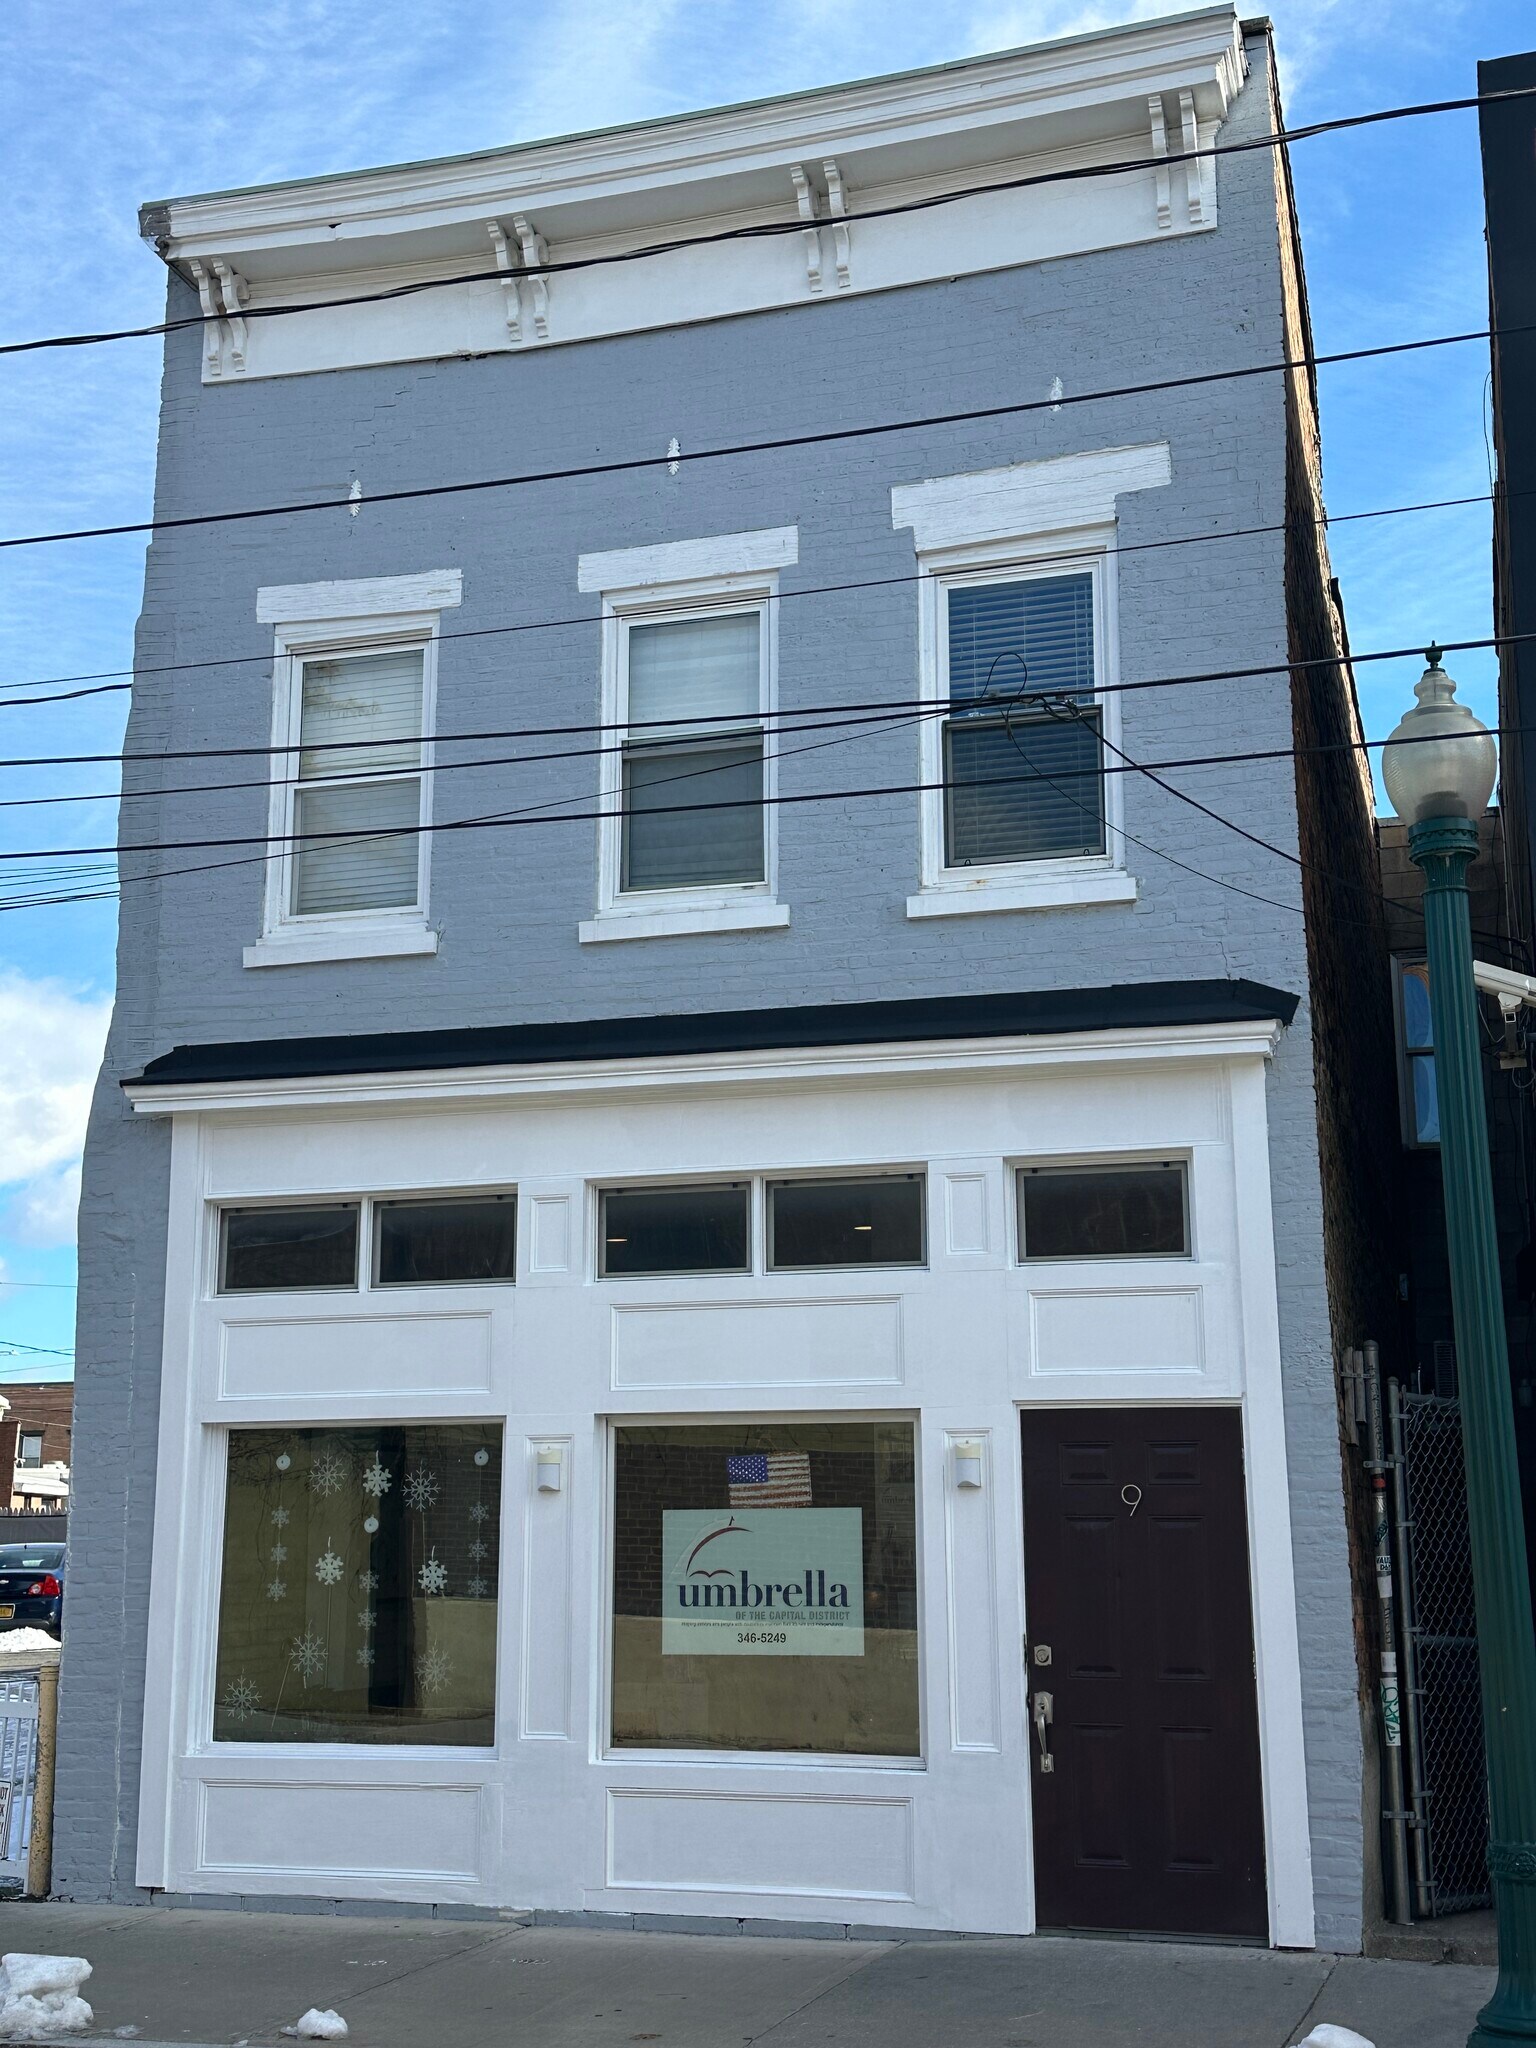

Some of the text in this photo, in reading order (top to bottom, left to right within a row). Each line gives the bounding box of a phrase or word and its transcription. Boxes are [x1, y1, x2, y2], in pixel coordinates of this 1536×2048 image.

[1121, 1484, 1142, 1517] 9
[676, 1570, 851, 1607] umbrella
[735, 1611, 850, 1620] OF THE CAPITAL DISTRICT
[737, 1632, 787, 1643] 346-5249
